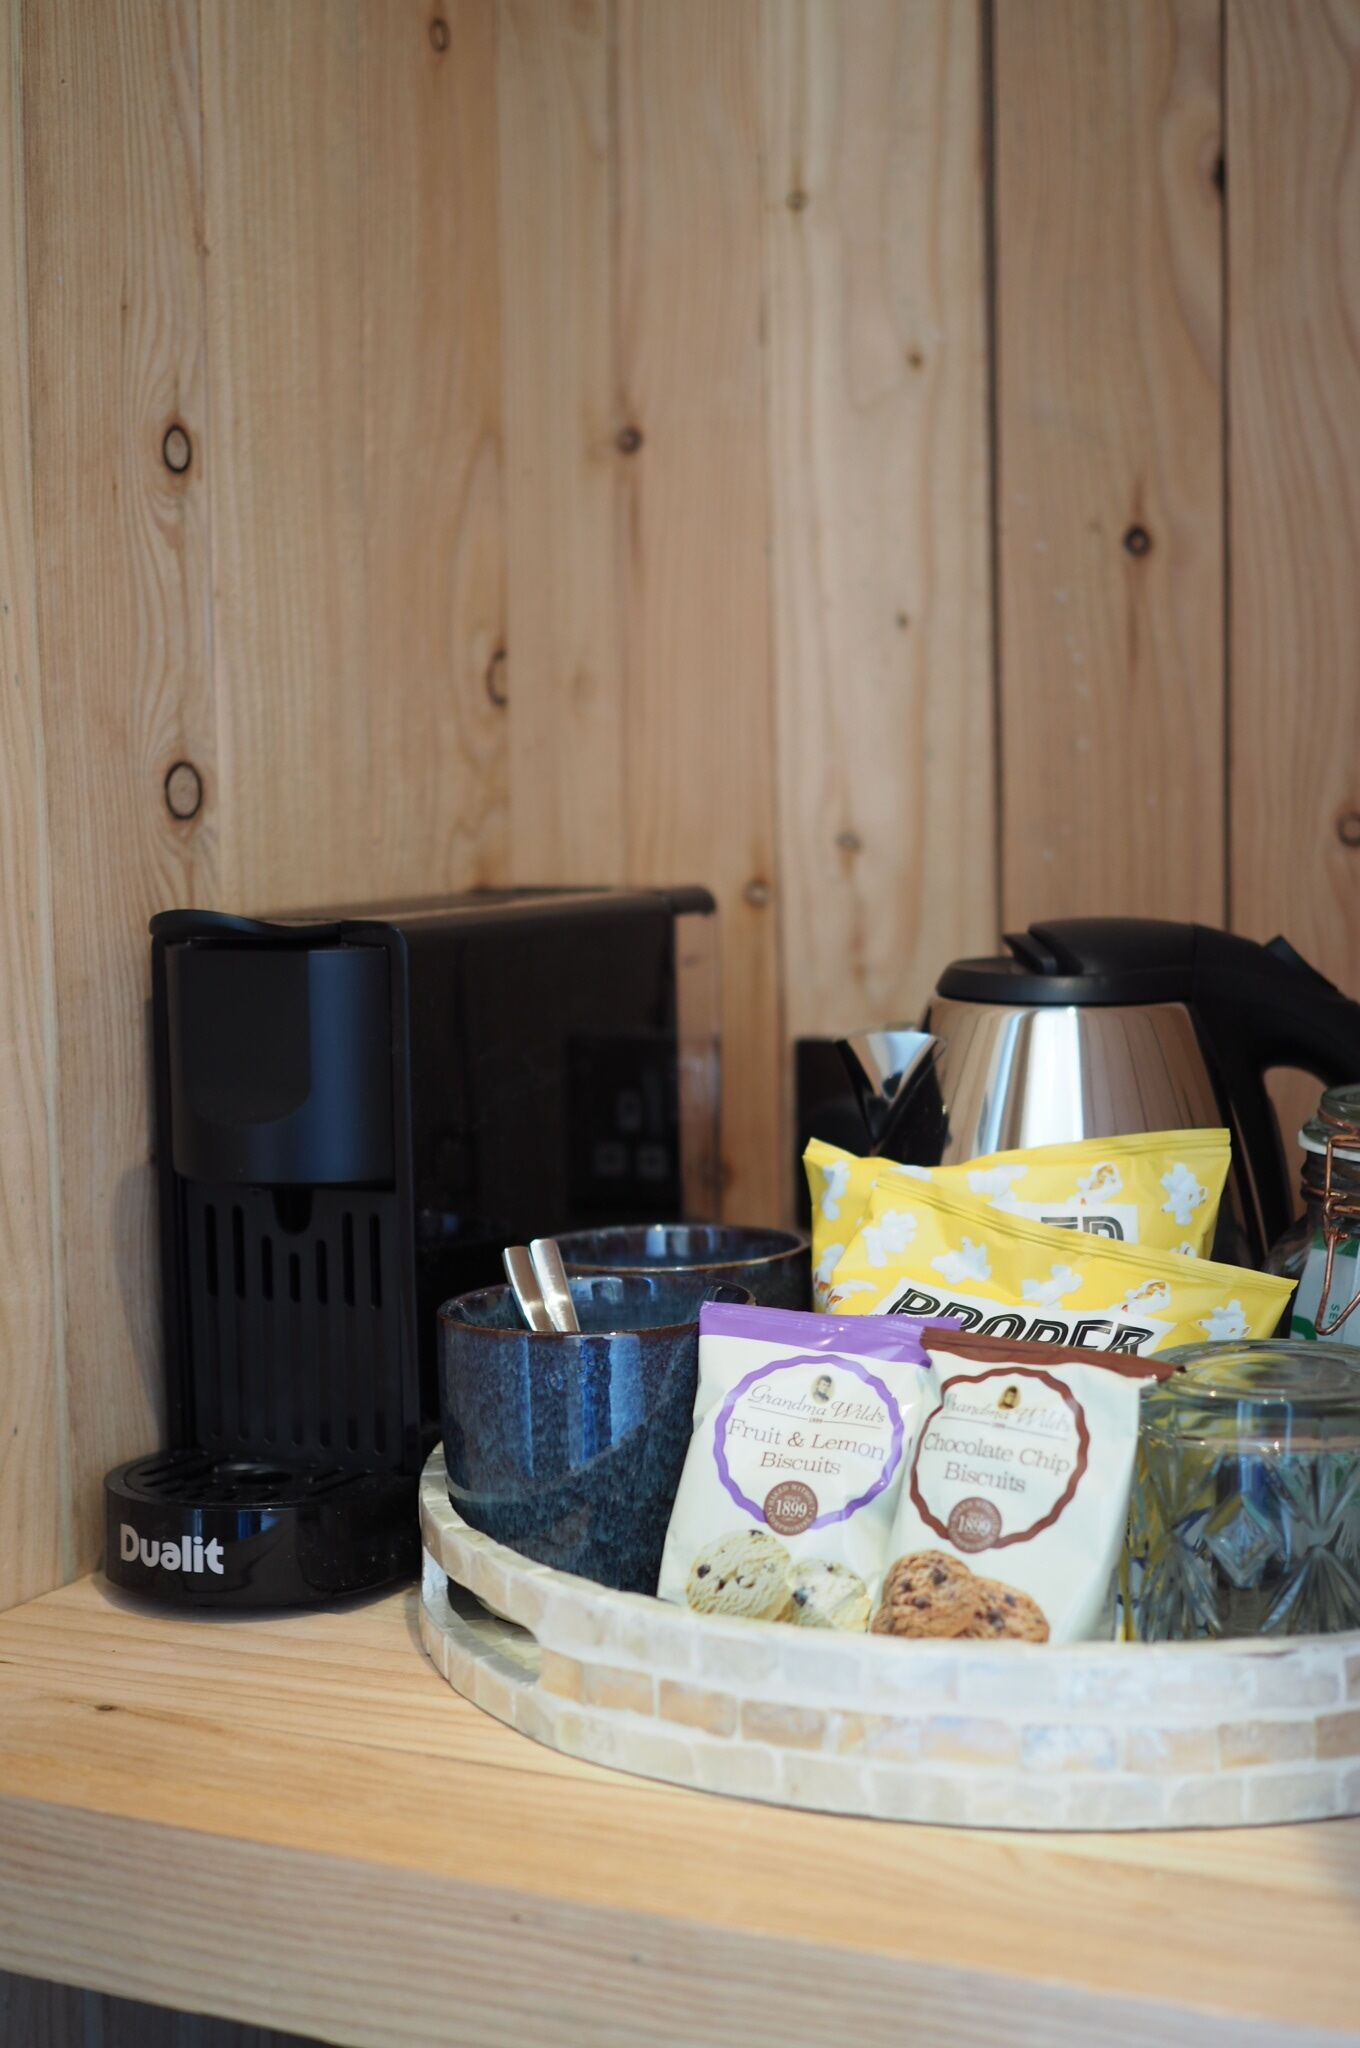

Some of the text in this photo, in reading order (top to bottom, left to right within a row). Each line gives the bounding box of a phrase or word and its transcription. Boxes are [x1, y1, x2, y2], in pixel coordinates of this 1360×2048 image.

[747, 1384, 885, 1423] Grandma Wild's
[728, 1418, 885, 1461] Fruit & Lemon
[923, 1432, 1071, 1476] Chocolate Chip
[760, 1451, 841, 1475] Biscuits
[943, 1461, 1027, 1493] Biscuits
[775, 1499, 808, 1518] 1899
[120, 1523, 224, 1575] Dualit
